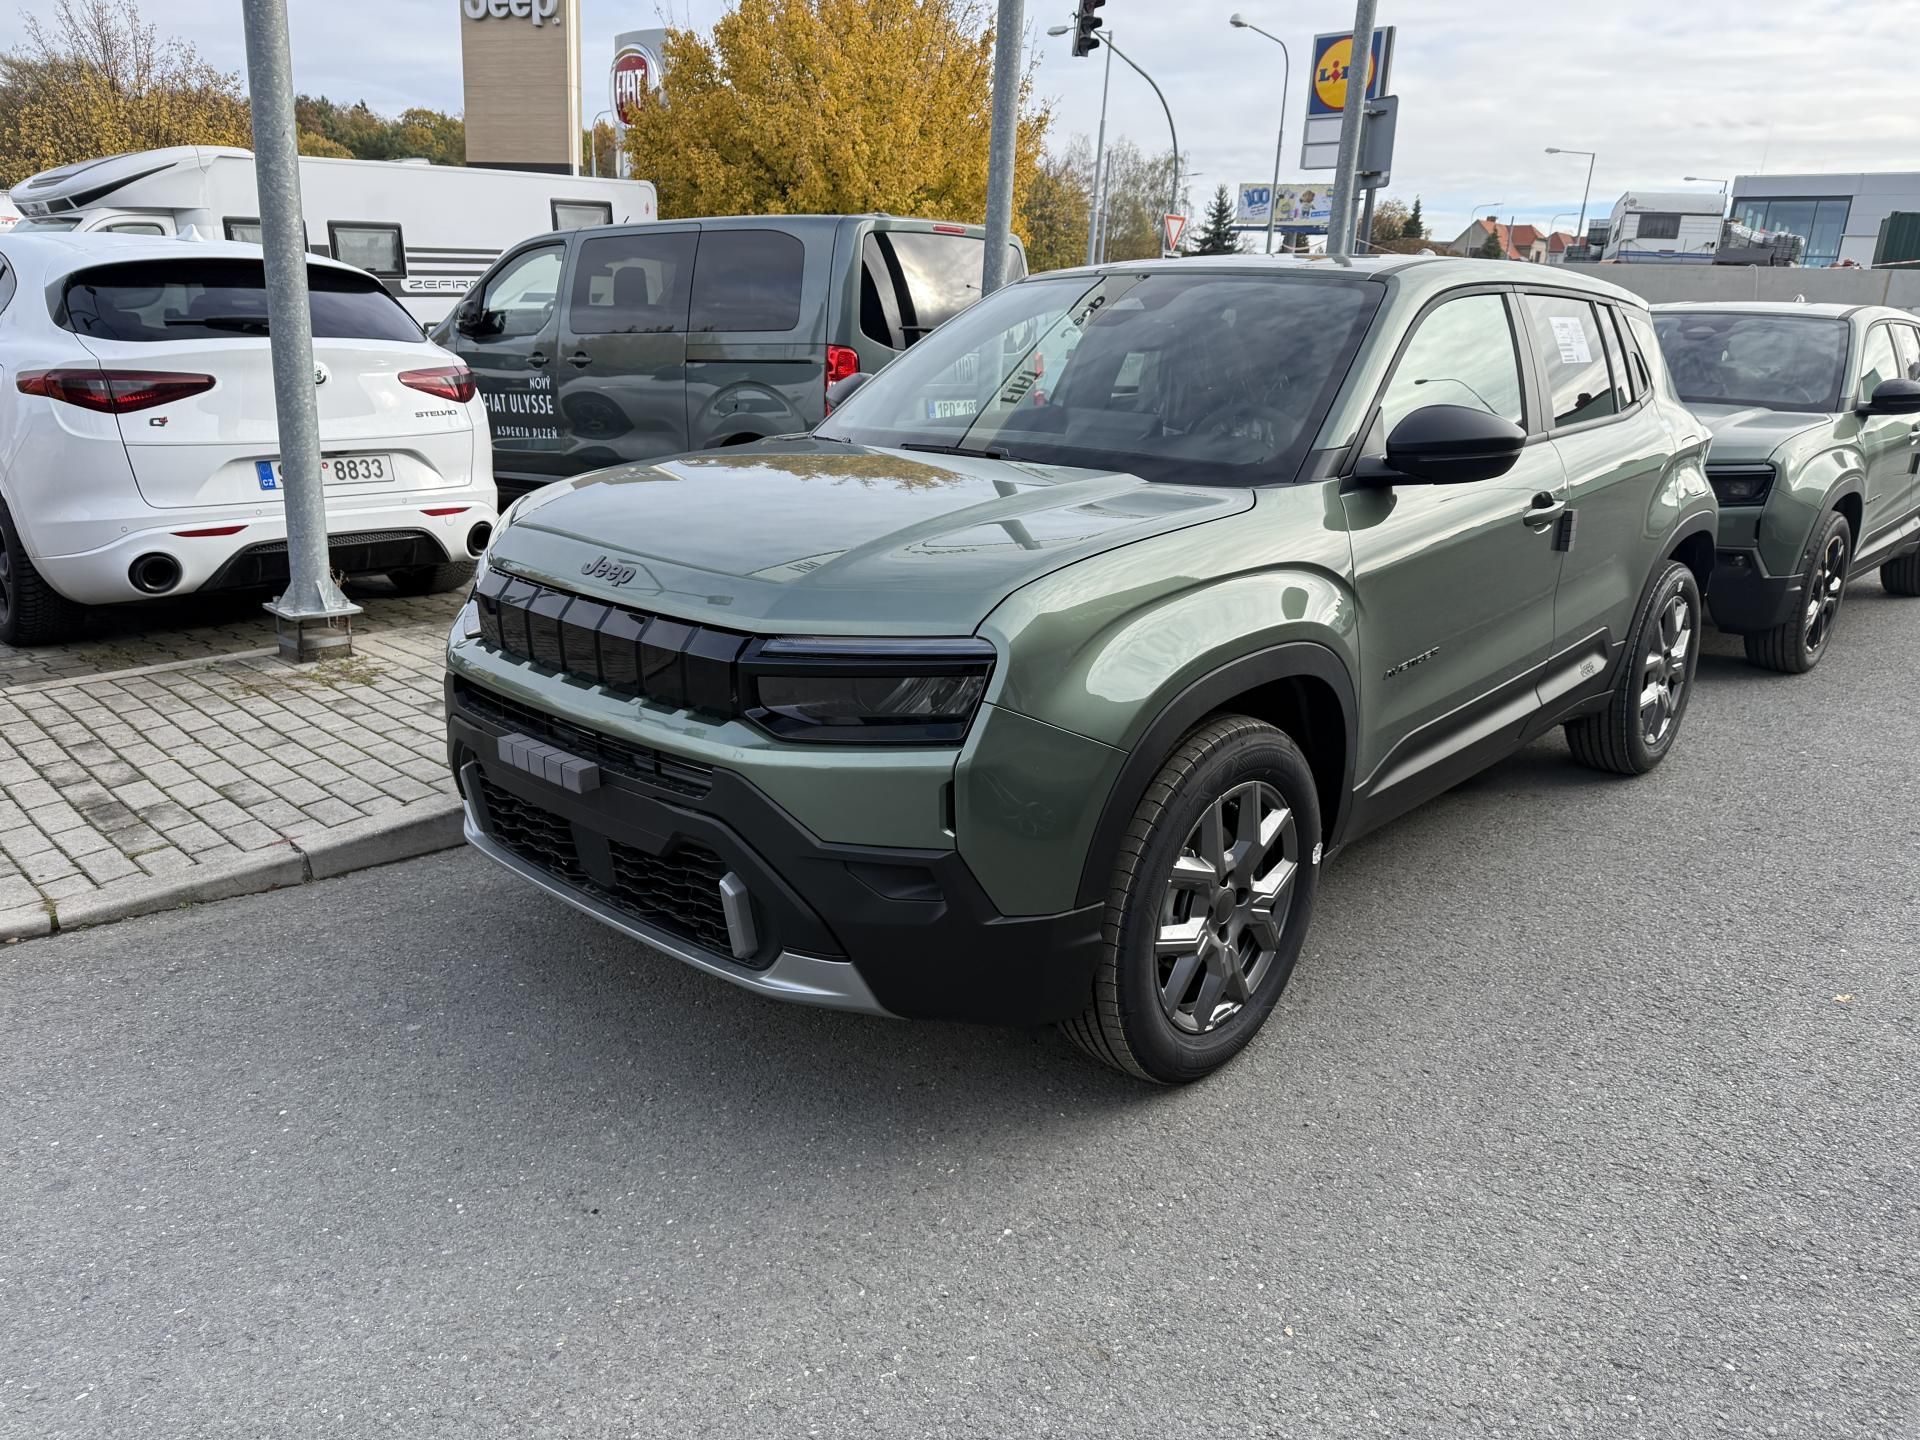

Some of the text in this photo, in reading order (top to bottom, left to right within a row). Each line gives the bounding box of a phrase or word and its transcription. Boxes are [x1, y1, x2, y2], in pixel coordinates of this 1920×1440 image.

[616, 69, 645, 109] FIAT
[529, 376, 551, 390] NOVÝ
[415, 410, 457, 418] STELVIO
[482, 393, 554, 415] FIAT ULYSSE
[496, 426, 558, 440] ASPEKTA PLZEŇ
[262, 458, 384, 487] CZ 8833
[581, 555, 637, 587] Jeep
